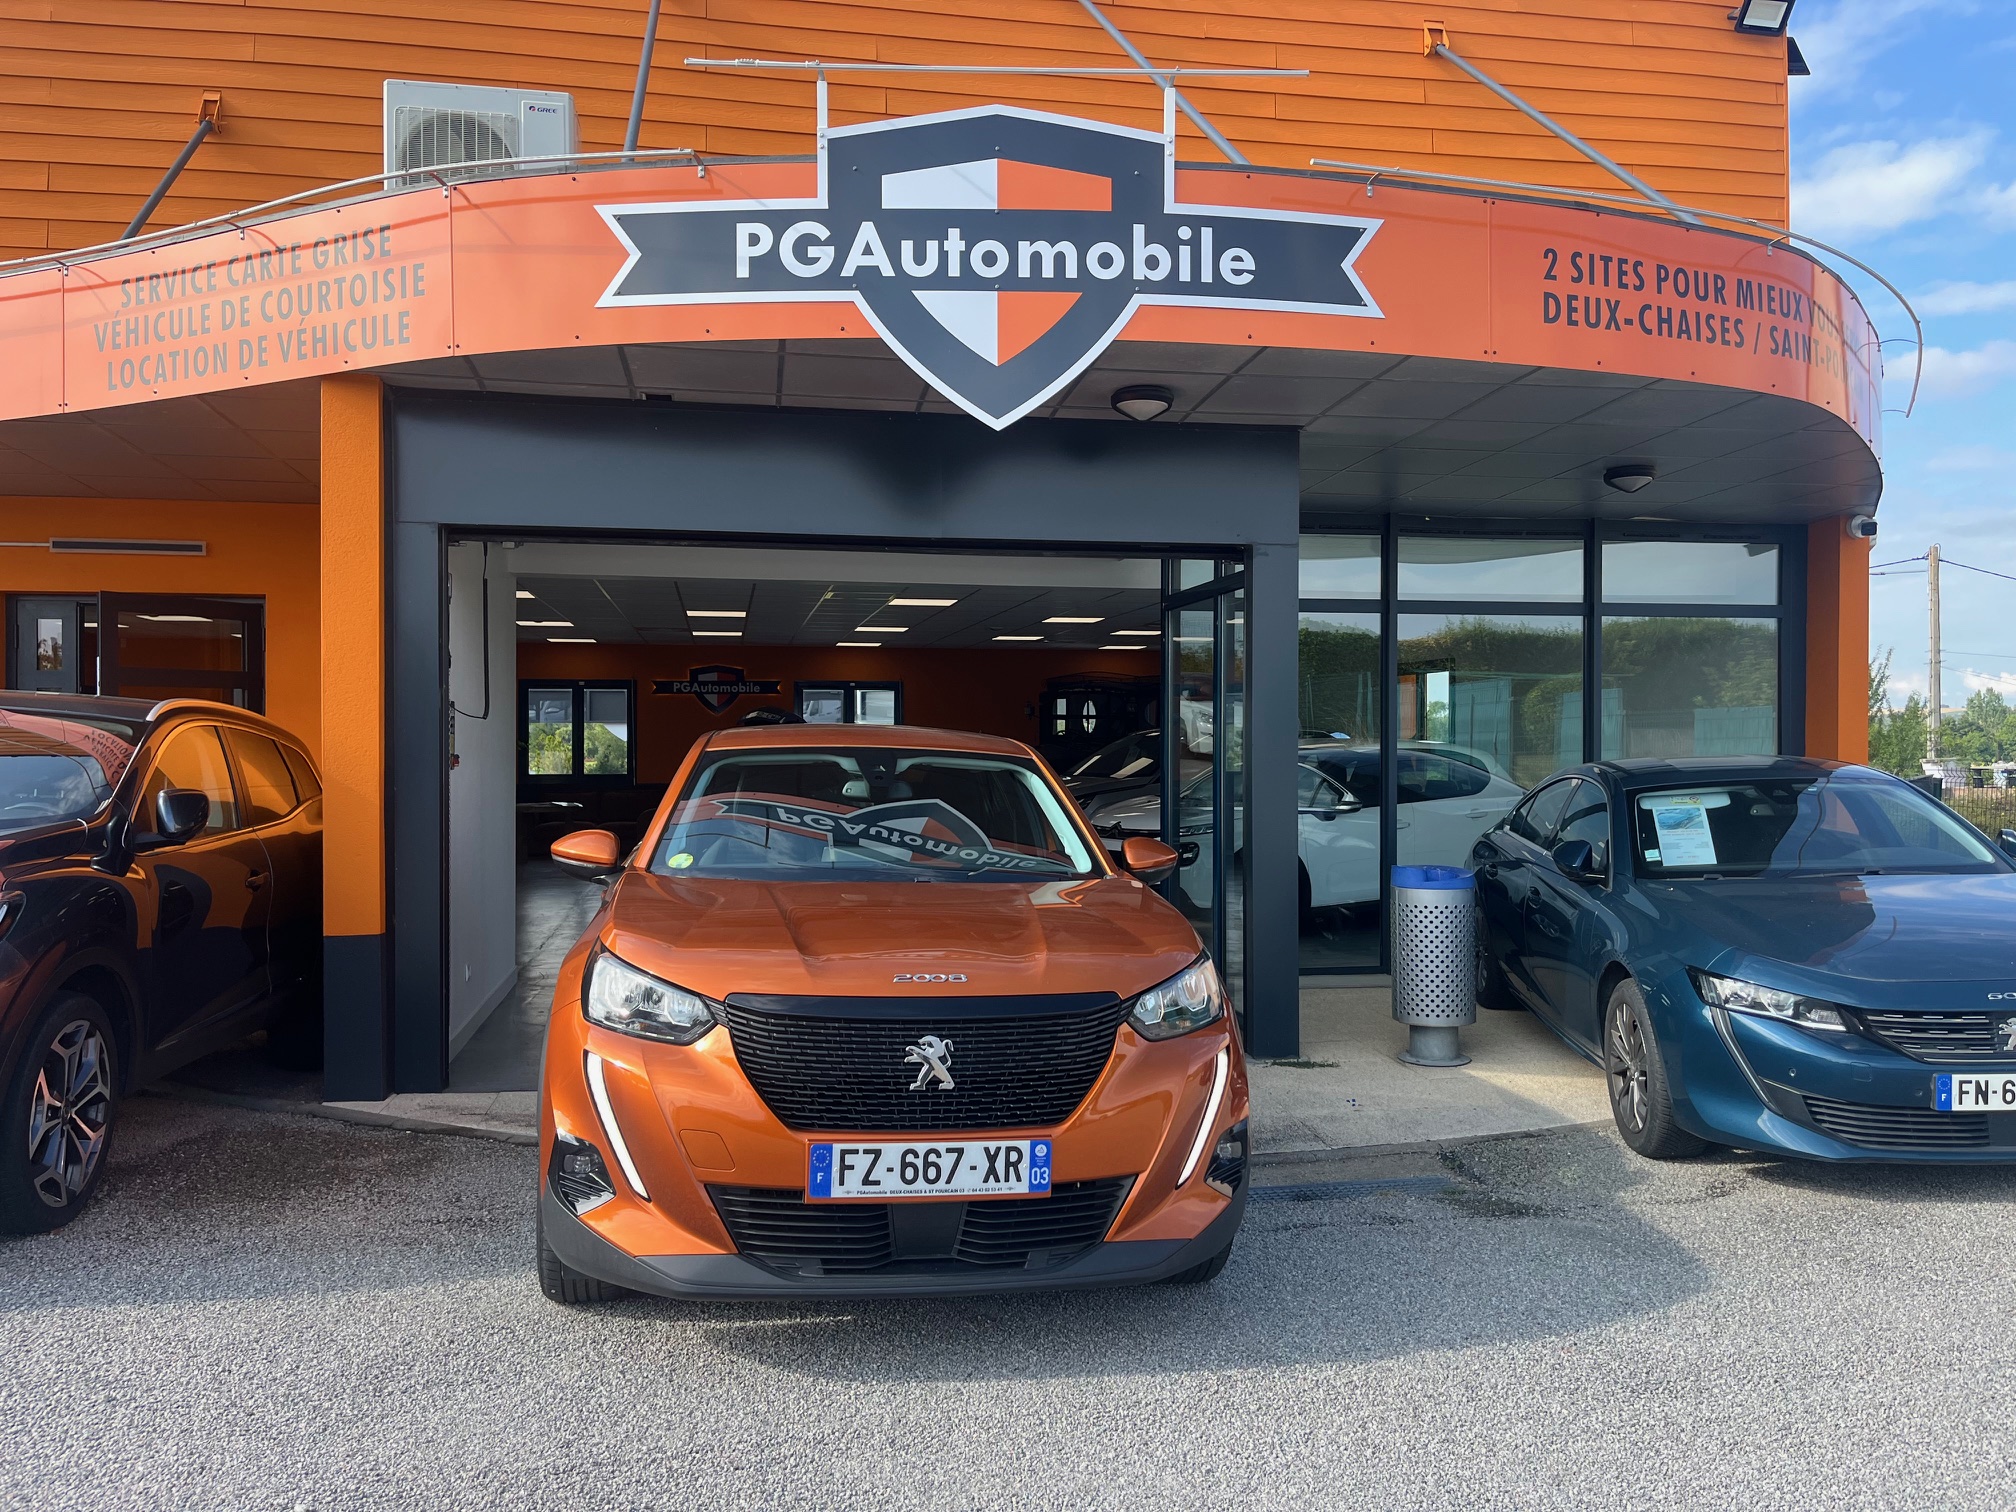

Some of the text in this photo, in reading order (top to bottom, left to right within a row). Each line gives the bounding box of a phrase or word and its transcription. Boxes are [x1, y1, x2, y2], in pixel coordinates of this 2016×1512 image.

[121, 223, 393, 308] SERVICE CARTE GRISE
[735, 221, 1256, 285] PGAutomobile
[94, 262, 427, 353] VÉHICULE DE COURTOISIE
[1543, 248, 1558, 281] 2
[1570, 251, 1645, 292] SITES
[1656, 263, 1727, 306] POUR
[1736, 278, 1804, 324] MIEUX
[1543, 291, 1745, 349] DEUX-CHAISES
[107, 310, 412, 391] LOCATION DE VÉHICULE
[673, 682, 761, 693] PGAutomobile
[893, 973, 968, 983] 2008
[1958, 1079, 2016, 1105] FN-6
[817, 1172, 824, 1183] F
[838, 1146, 1025, 1186] FZ-667-XR
[1031, 1166, 1049, 1184] 03
